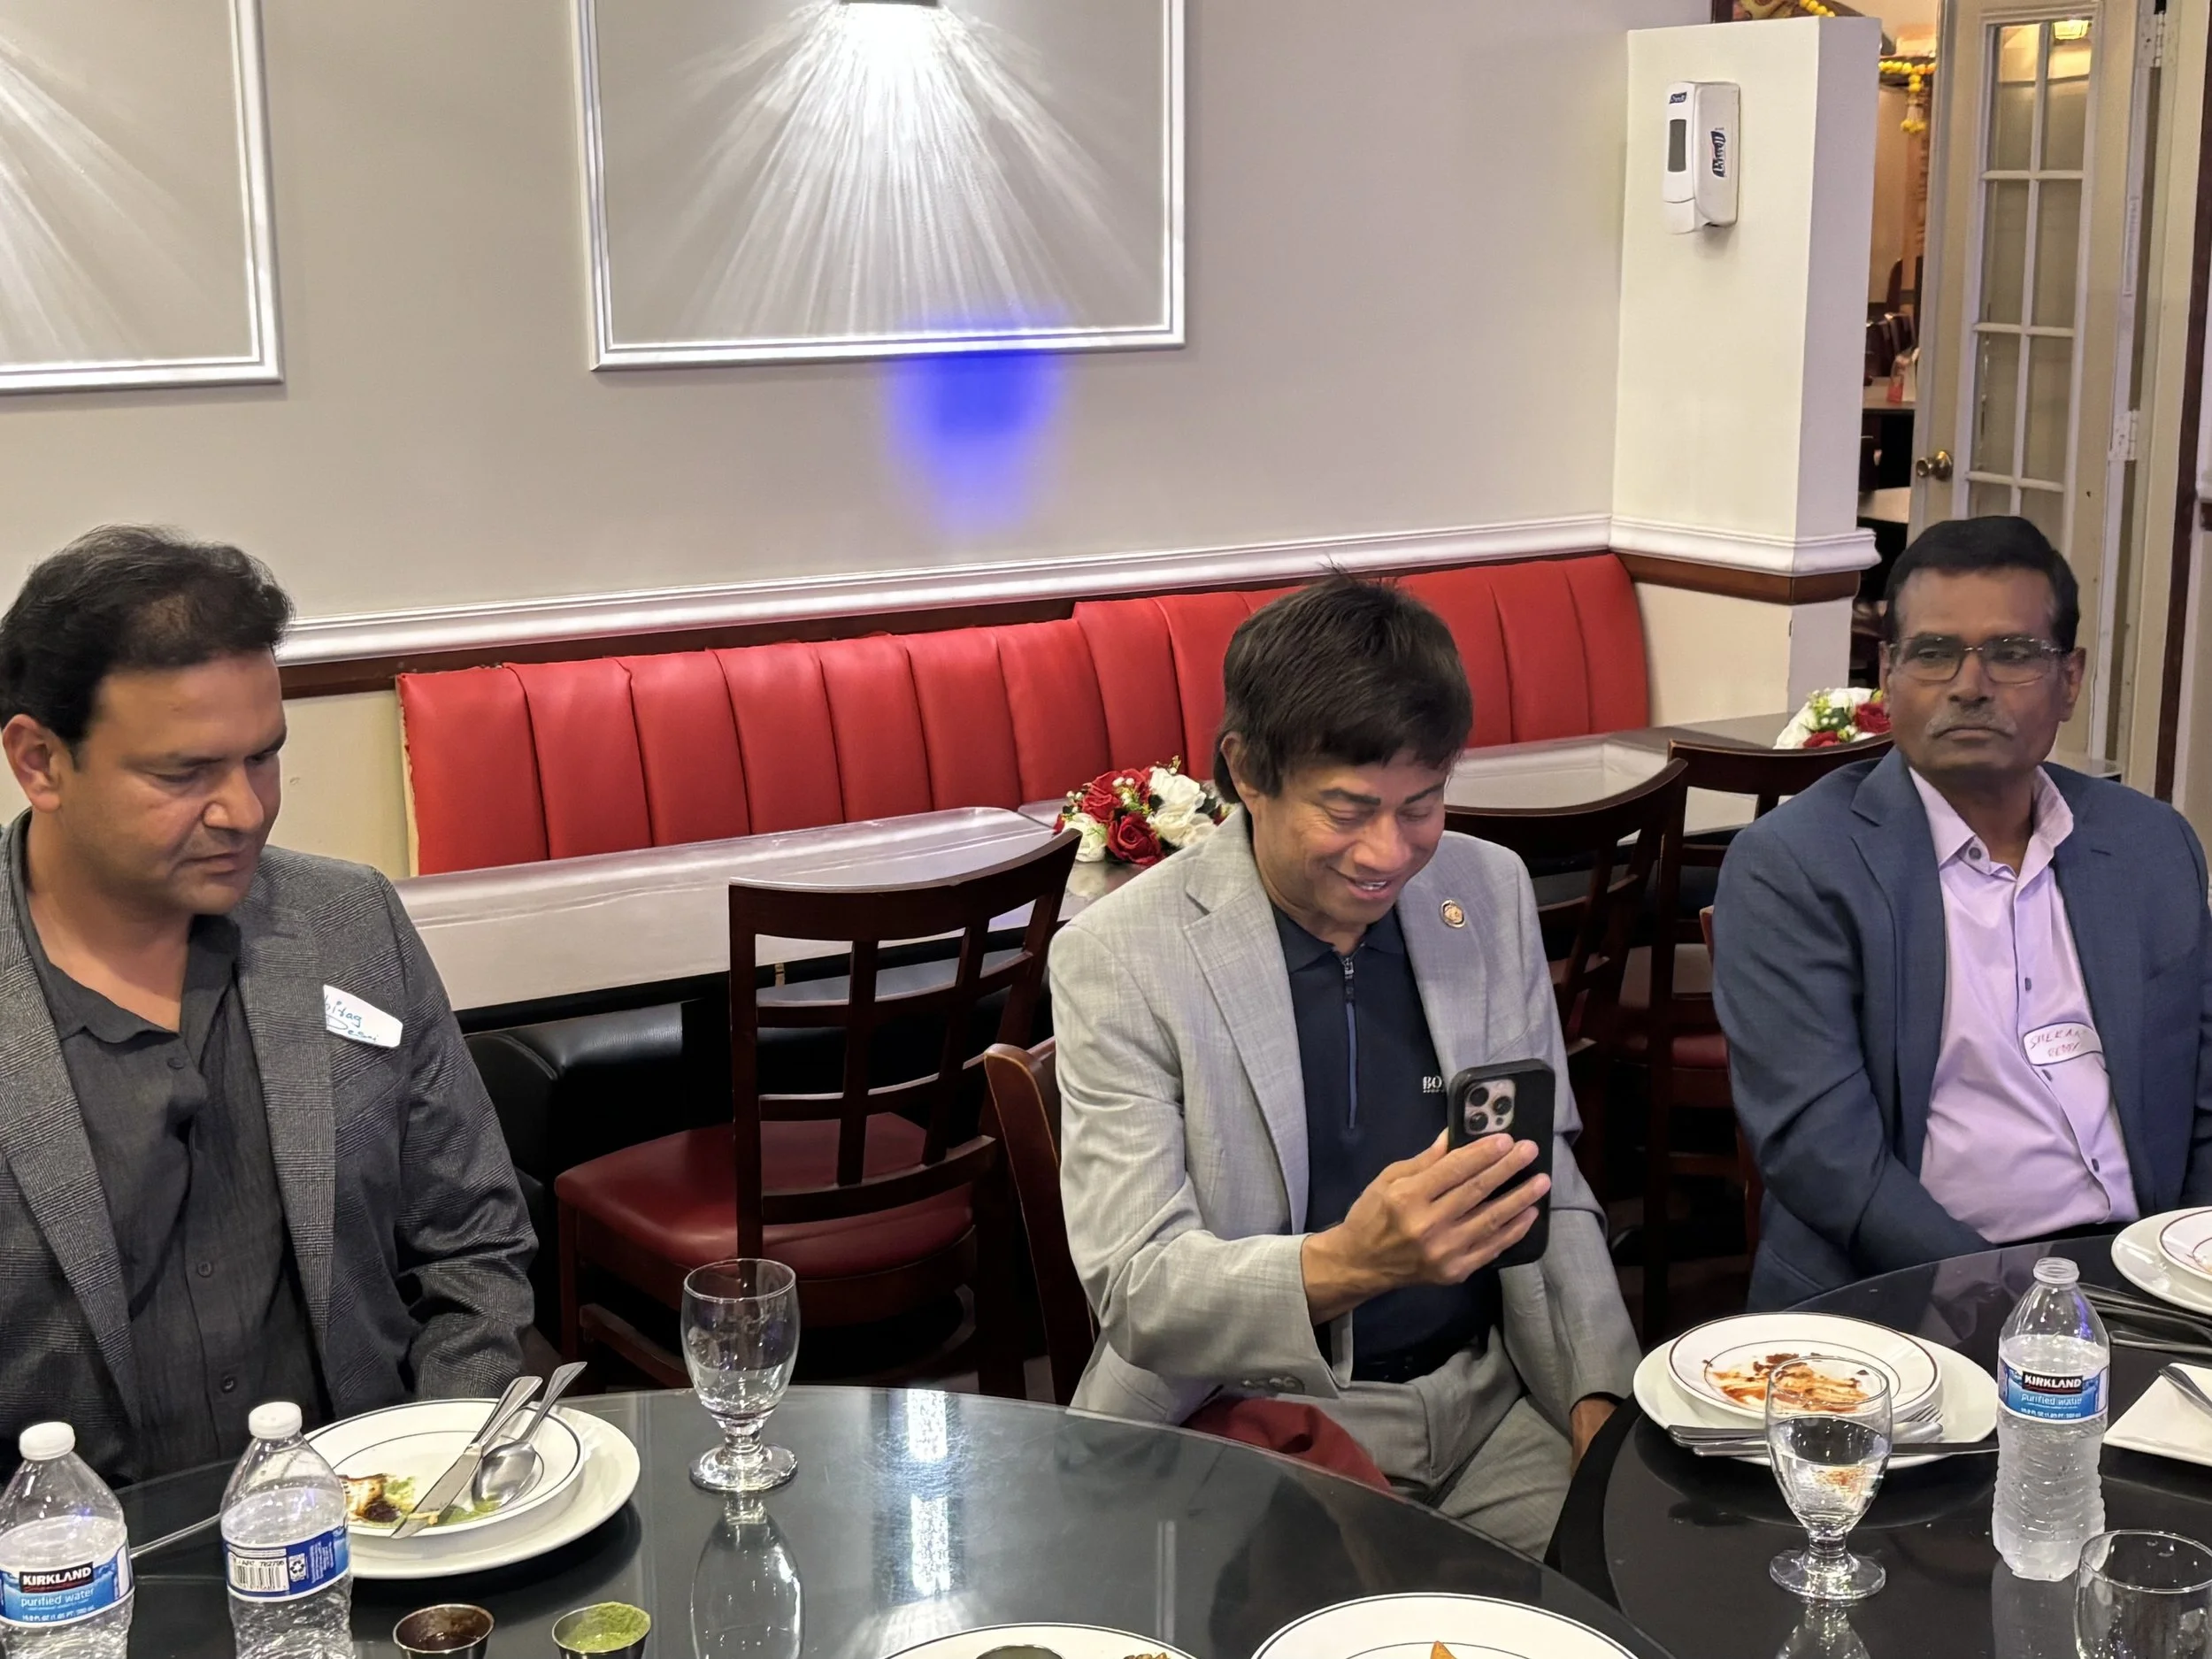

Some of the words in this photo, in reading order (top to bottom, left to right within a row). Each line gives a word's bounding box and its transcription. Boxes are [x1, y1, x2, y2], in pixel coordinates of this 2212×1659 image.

[2024, 1374, 2082, 1388] KIRKLAND
[23, 1567, 92, 1586] KIRKLAND
[20, 1594, 62, 1608] purified
[65, 1588, 95, 1601] water
